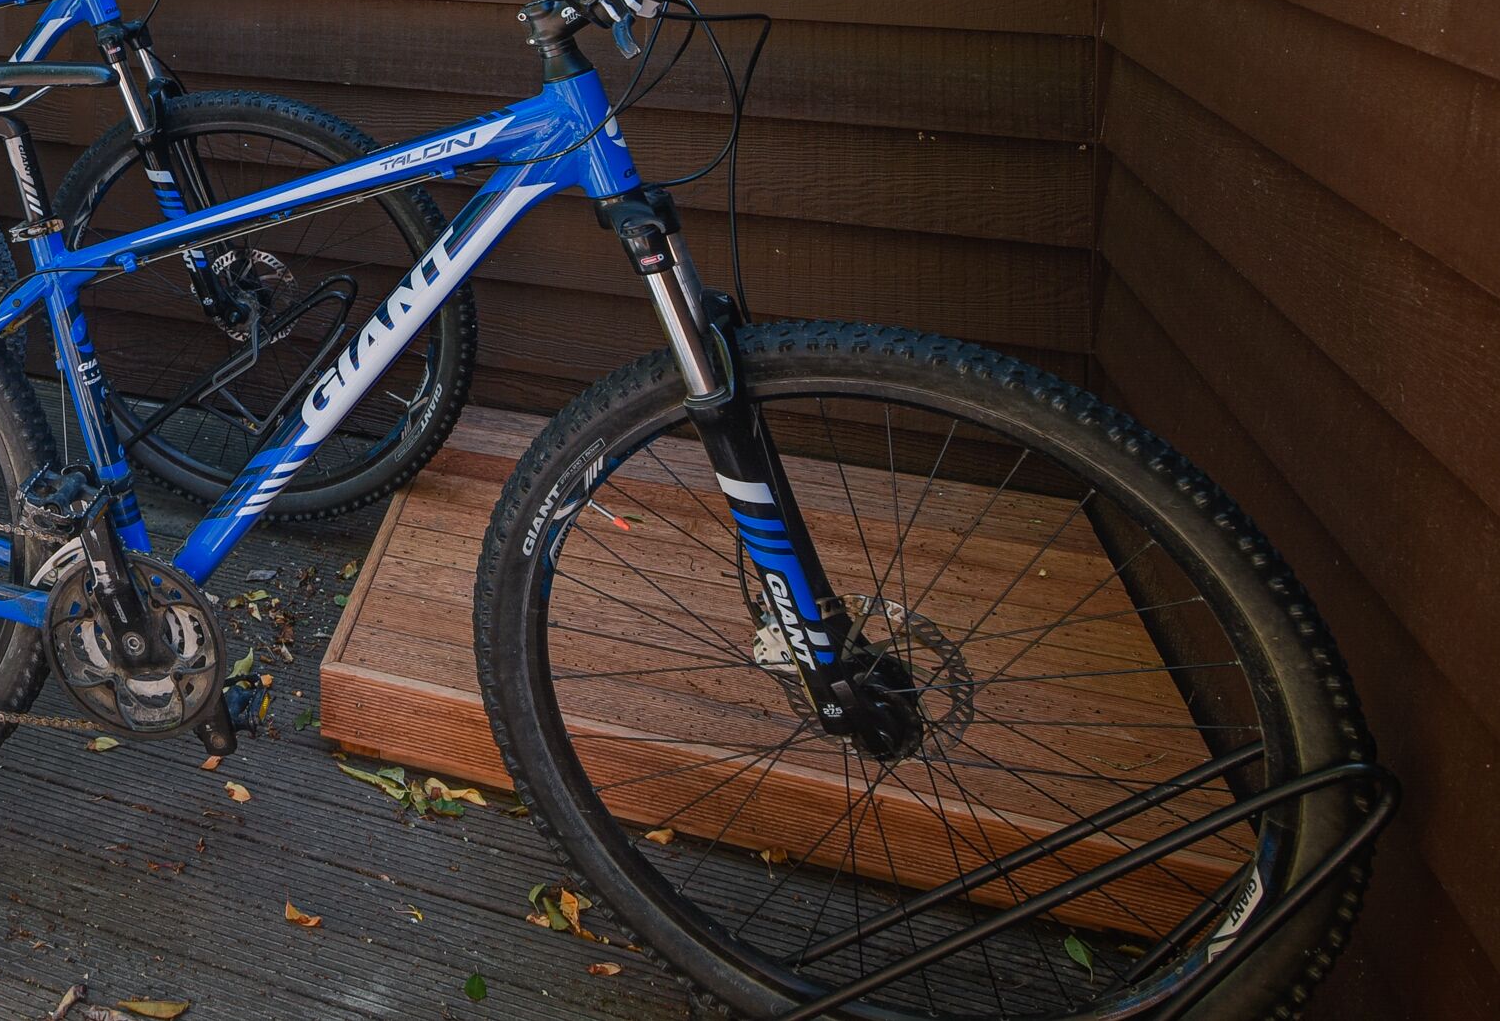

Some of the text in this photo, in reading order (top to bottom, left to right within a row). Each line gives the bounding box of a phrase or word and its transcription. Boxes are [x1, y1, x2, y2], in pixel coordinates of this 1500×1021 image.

[18, 144, 34, 177] GIANT
[379, 131, 477, 171] TALON
[301, 225, 454, 427] GIANT
[419, 382, 443, 433] GIANT
[522, 483, 561, 557] GIANT
[765, 572, 818, 672] GIANT
[1229, 877, 1258, 928] GIANT
